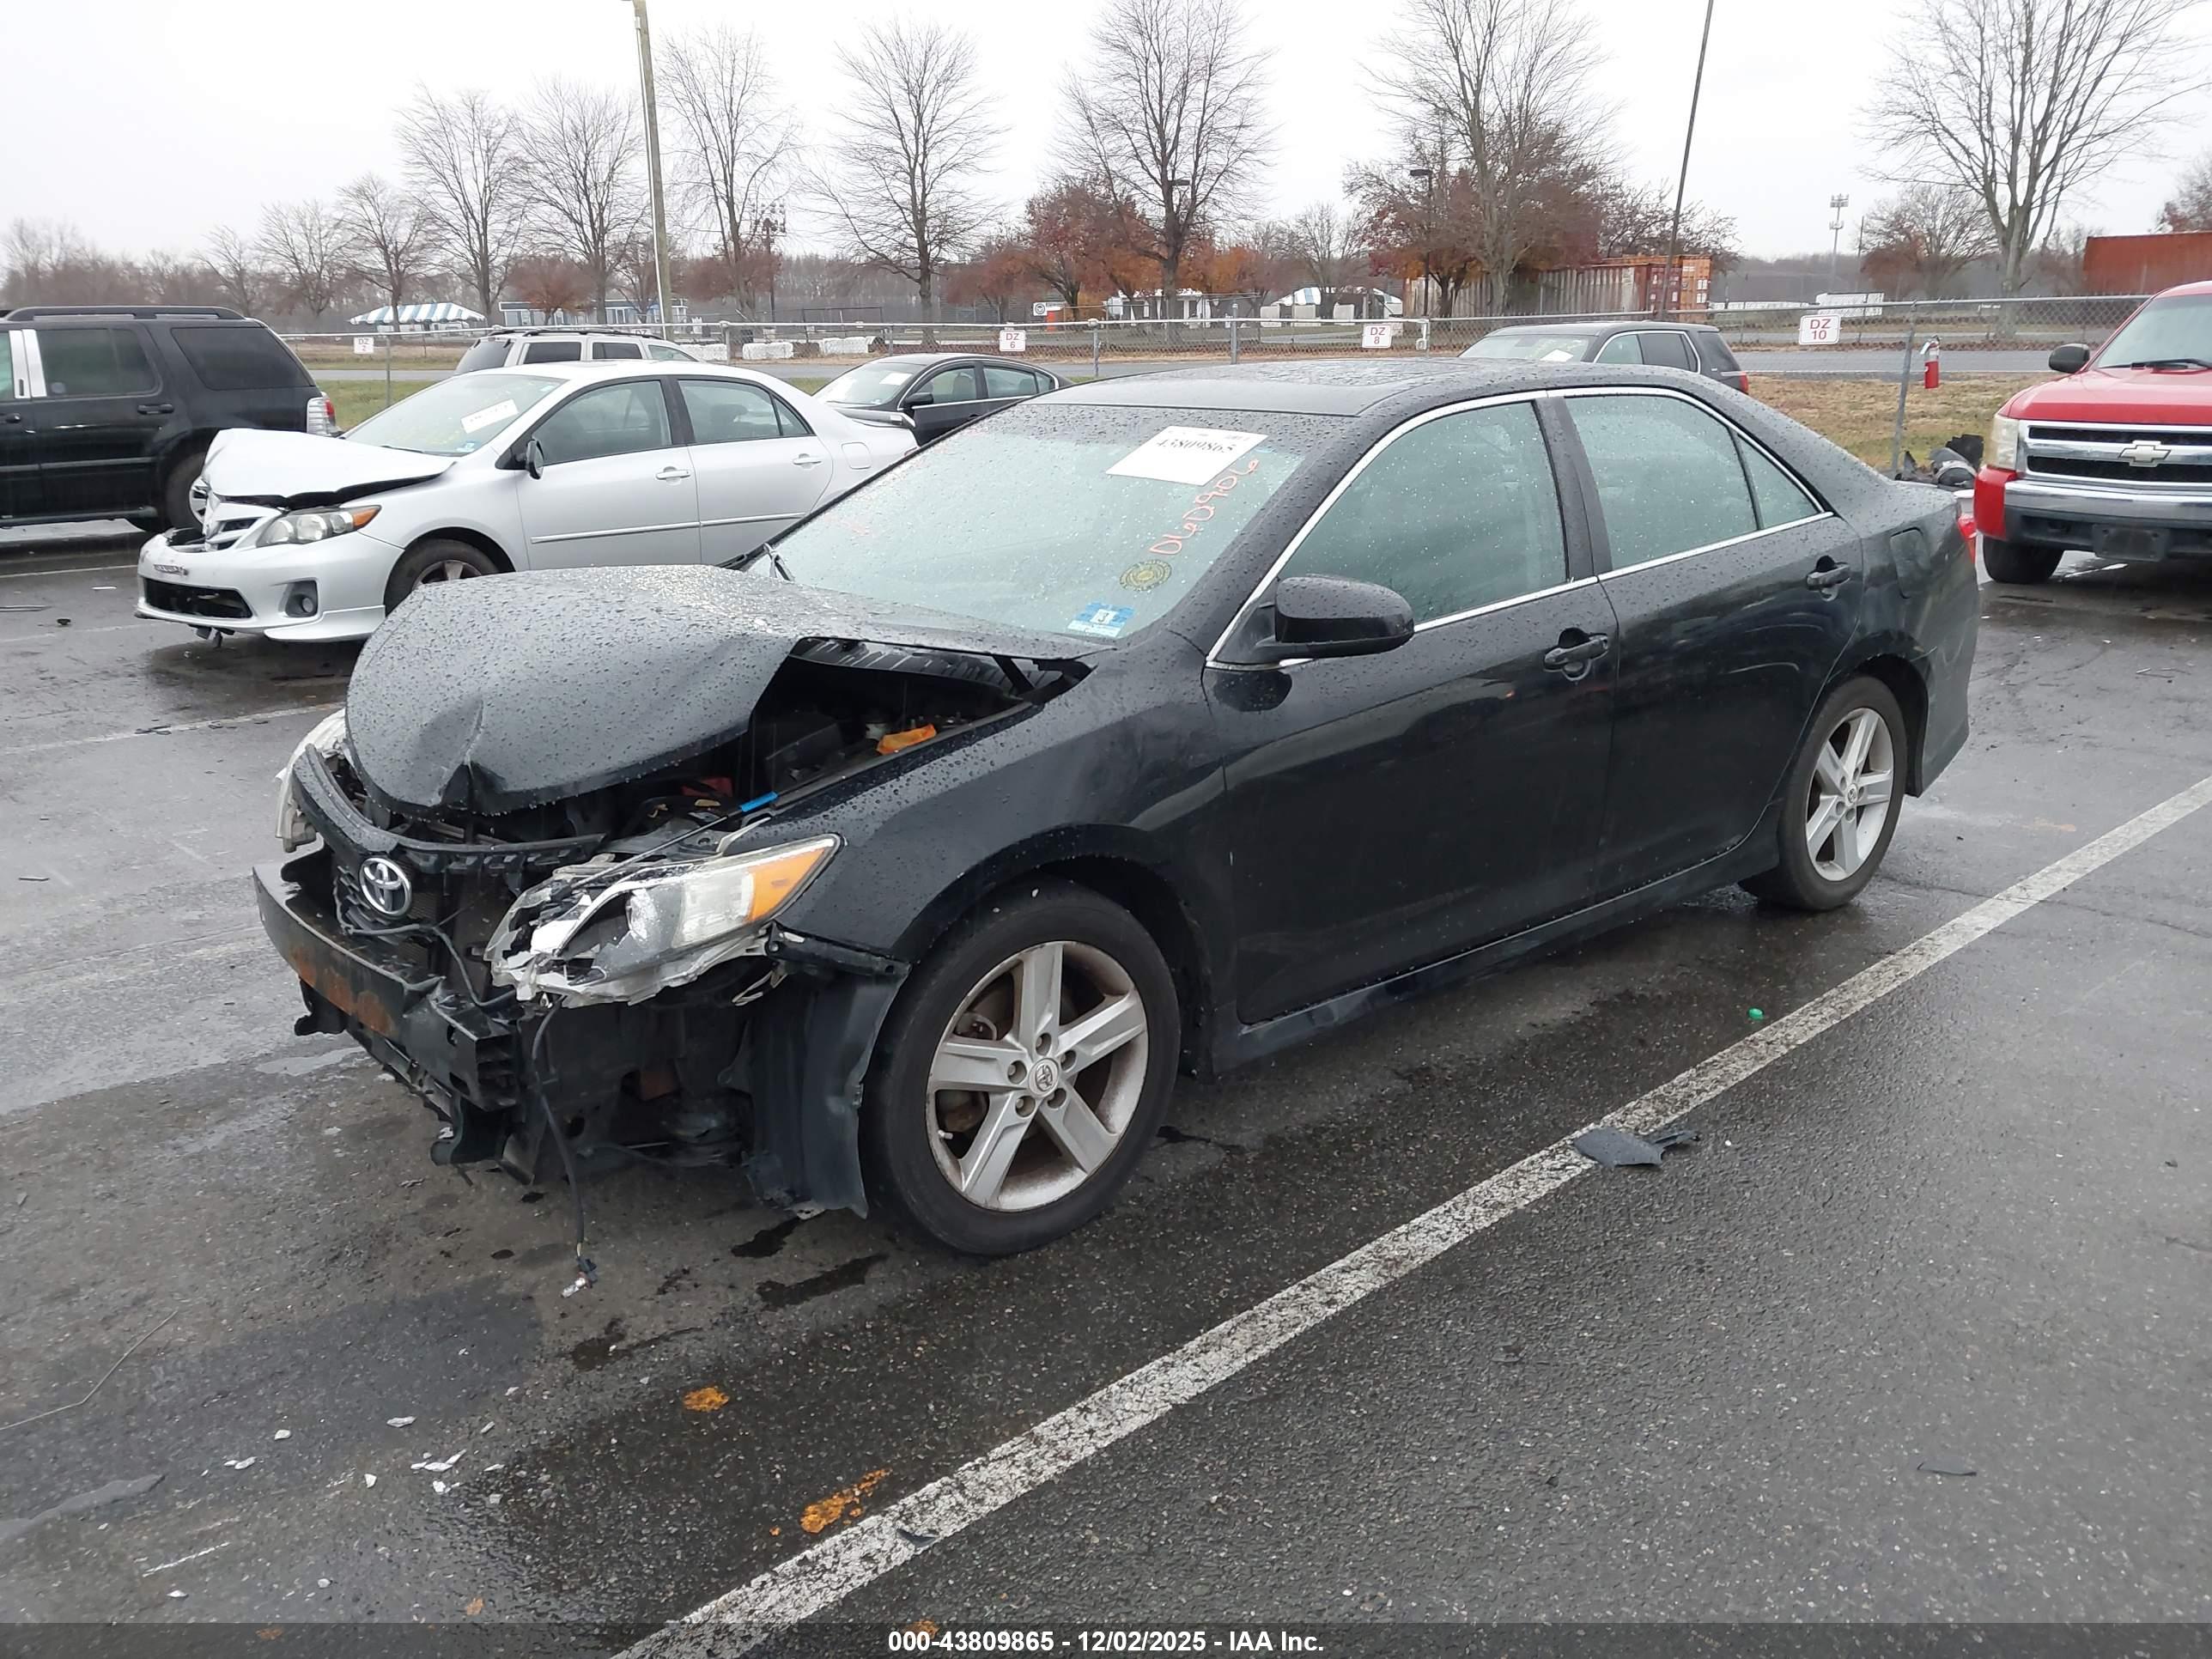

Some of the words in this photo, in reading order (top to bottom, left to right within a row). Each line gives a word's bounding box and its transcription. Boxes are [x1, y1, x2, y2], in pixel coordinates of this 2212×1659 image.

[1809, 319, 1832, 330] DZ
[1370, 326, 1386, 336] DZ
[1811, 329, 1827, 340] 10
[1006, 332, 1020, 341] DZ
[1374, 336, 1380, 344] 8
